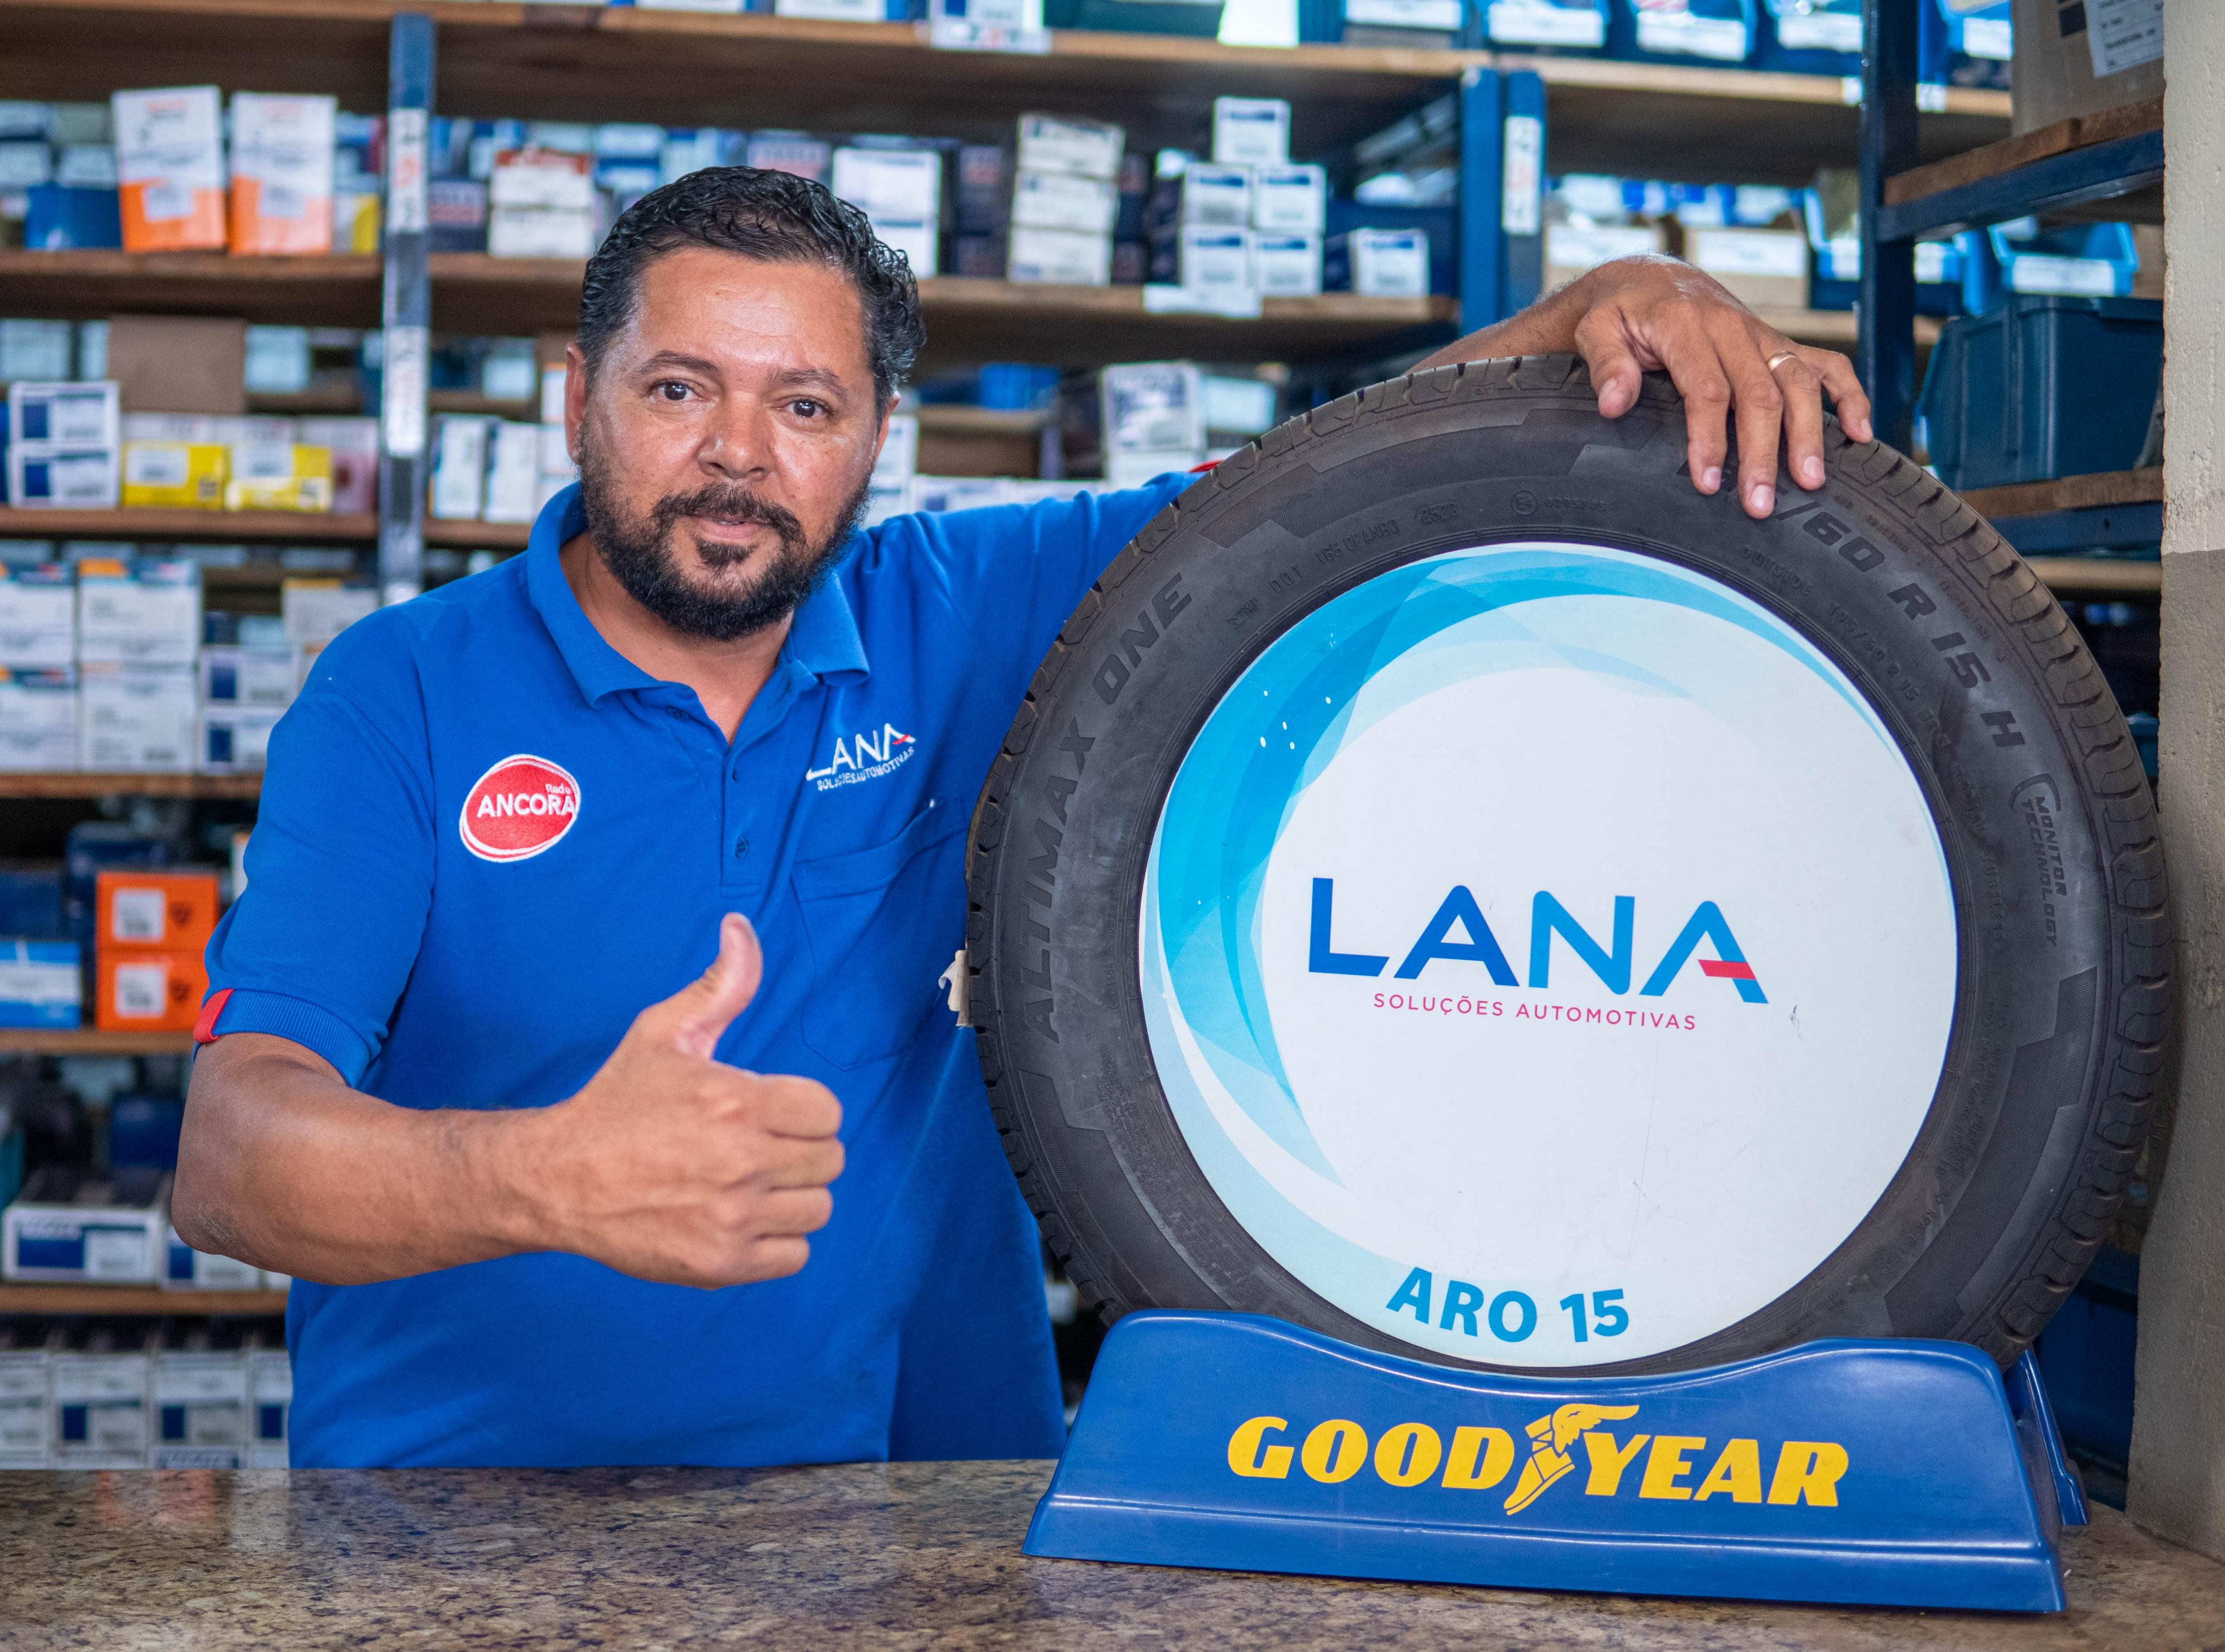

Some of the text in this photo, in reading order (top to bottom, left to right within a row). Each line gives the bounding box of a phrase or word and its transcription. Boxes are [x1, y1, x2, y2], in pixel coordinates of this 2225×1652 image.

[1740, 544, 1814, 597] OUTSIDE
[1887, 582, 1938, 620] R
[1930, 631, 1992, 689] 15
[1979, 710, 2026, 748] H
[1896, 677, 1921, 703] 15
[545, 782, 571, 794] Rede
[806, 723, 916, 781] LANA
[476, 793, 576, 818] ANCORA
[1020, 572, 1192, 1044] ALTIMAX ONE
[2020, 798, 2058, 948] TECHNOLOGY
[2034, 796, 2066, 897] MONITOR
[1309, 877, 1769, 1004] LANA
[1373, 993, 1696, 1030] SOLUÇÕES AUTOMOTIVAS
[1386, 1266, 1629, 1342] ARO 15
[1228, 1415, 1849, 1506] GOODYEAR
